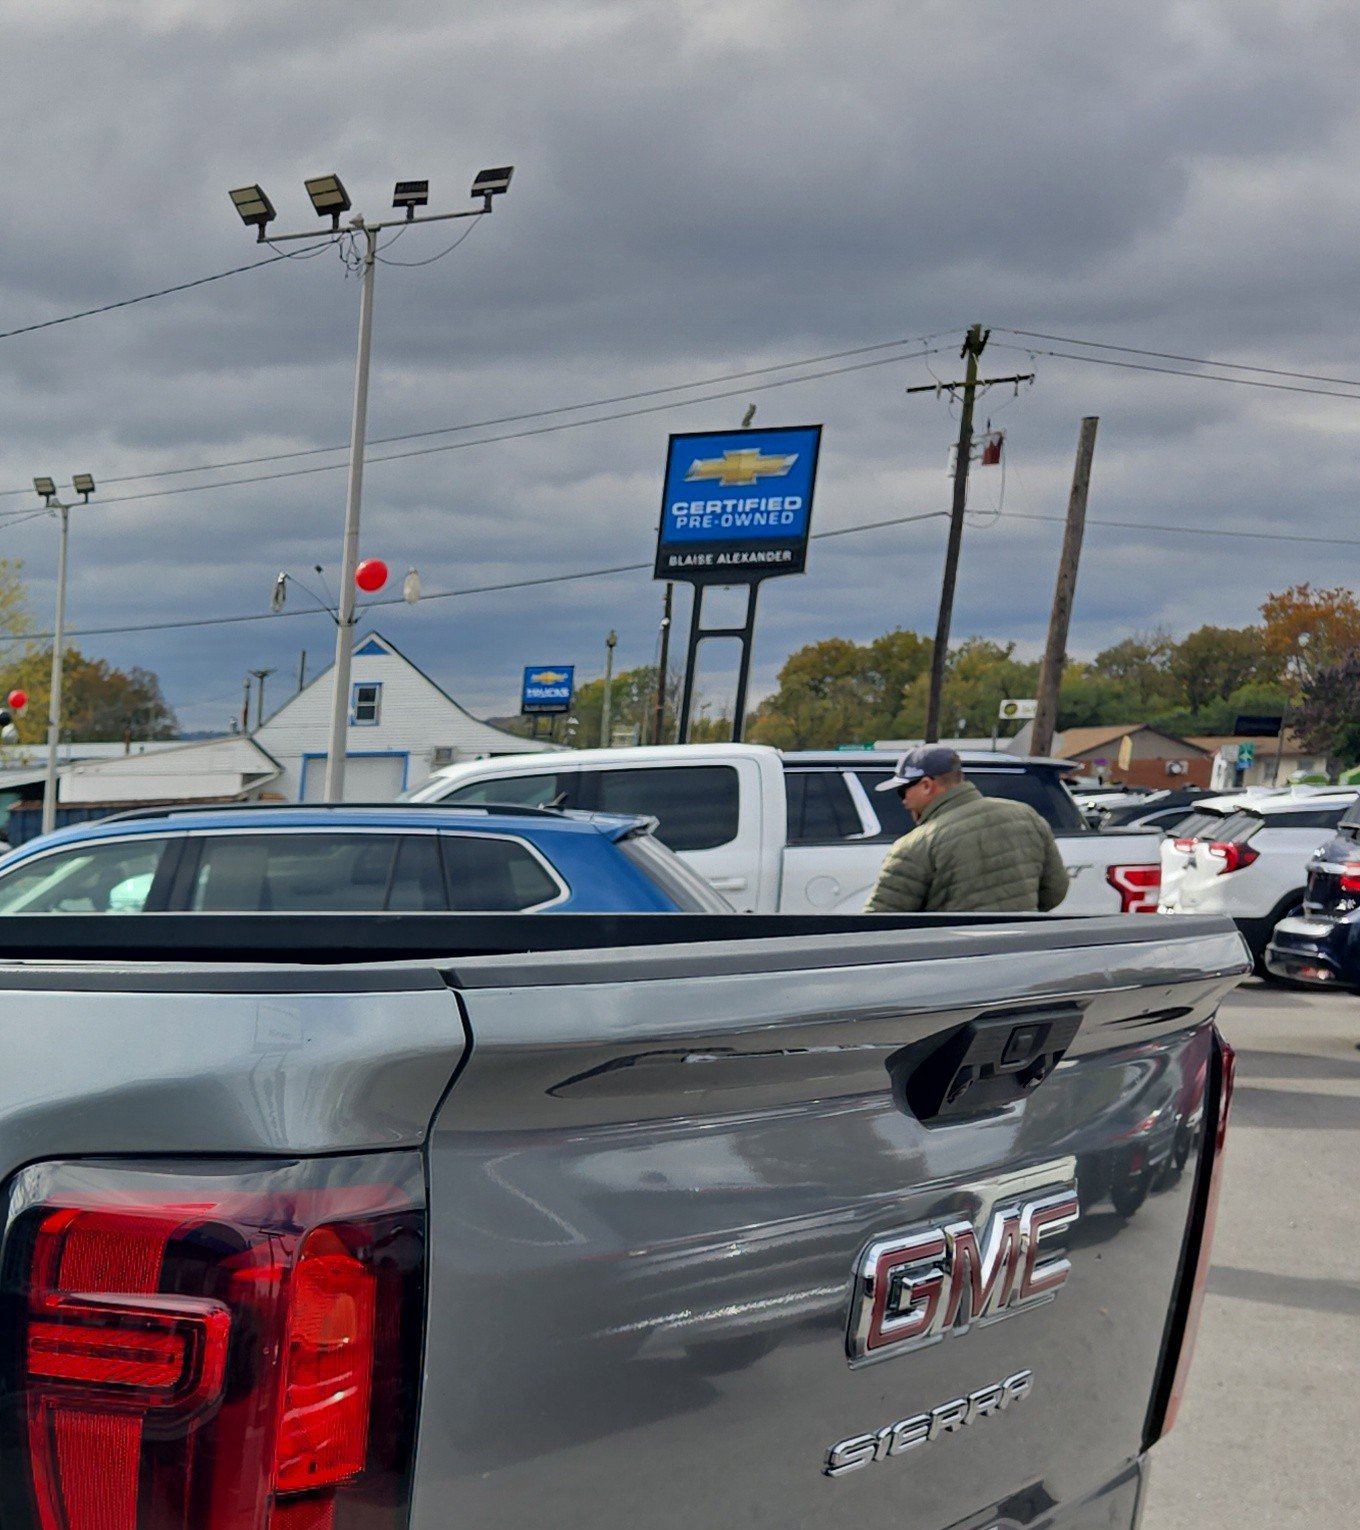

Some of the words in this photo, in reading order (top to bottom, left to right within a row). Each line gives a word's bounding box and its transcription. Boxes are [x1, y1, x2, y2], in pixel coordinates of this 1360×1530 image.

[672, 496, 802, 516] CERTIFIED
[676, 511, 794, 529] PRE-OWNED
[668, 554, 714, 567] BLAISE
[716, 550, 792, 564] ALEXANDER
[844, 1176, 1080, 1370] GMC
[821, 1368, 1035, 1478] SIERRA
